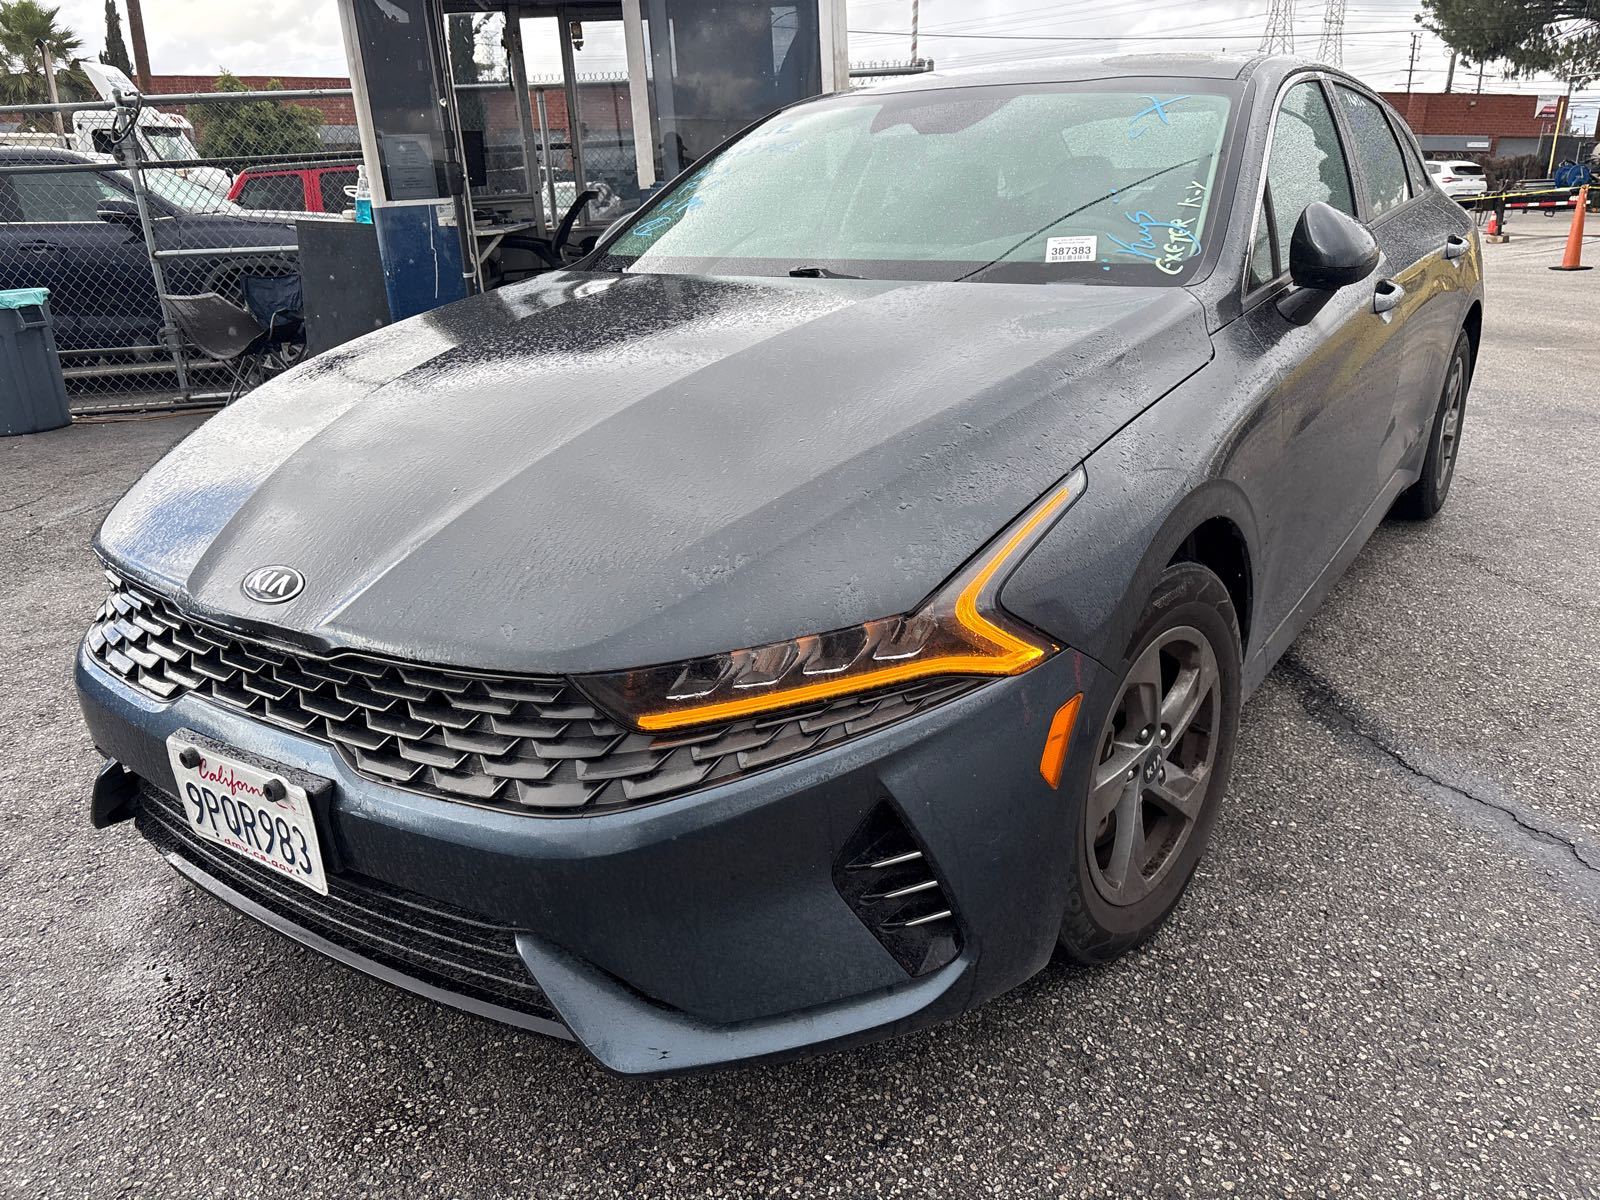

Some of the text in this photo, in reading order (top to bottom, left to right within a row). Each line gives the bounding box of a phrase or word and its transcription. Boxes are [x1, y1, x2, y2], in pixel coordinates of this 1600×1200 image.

[1051, 246, 1092, 256] 387383
[247, 569, 292, 596] KIA
[1146, 753, 1162, 779] KIA
[198, 757, 289, 810] Californ
[185, 781, 313, 875] 9PQR983
[224, 838, 294, 875] dmv.ca.gov
